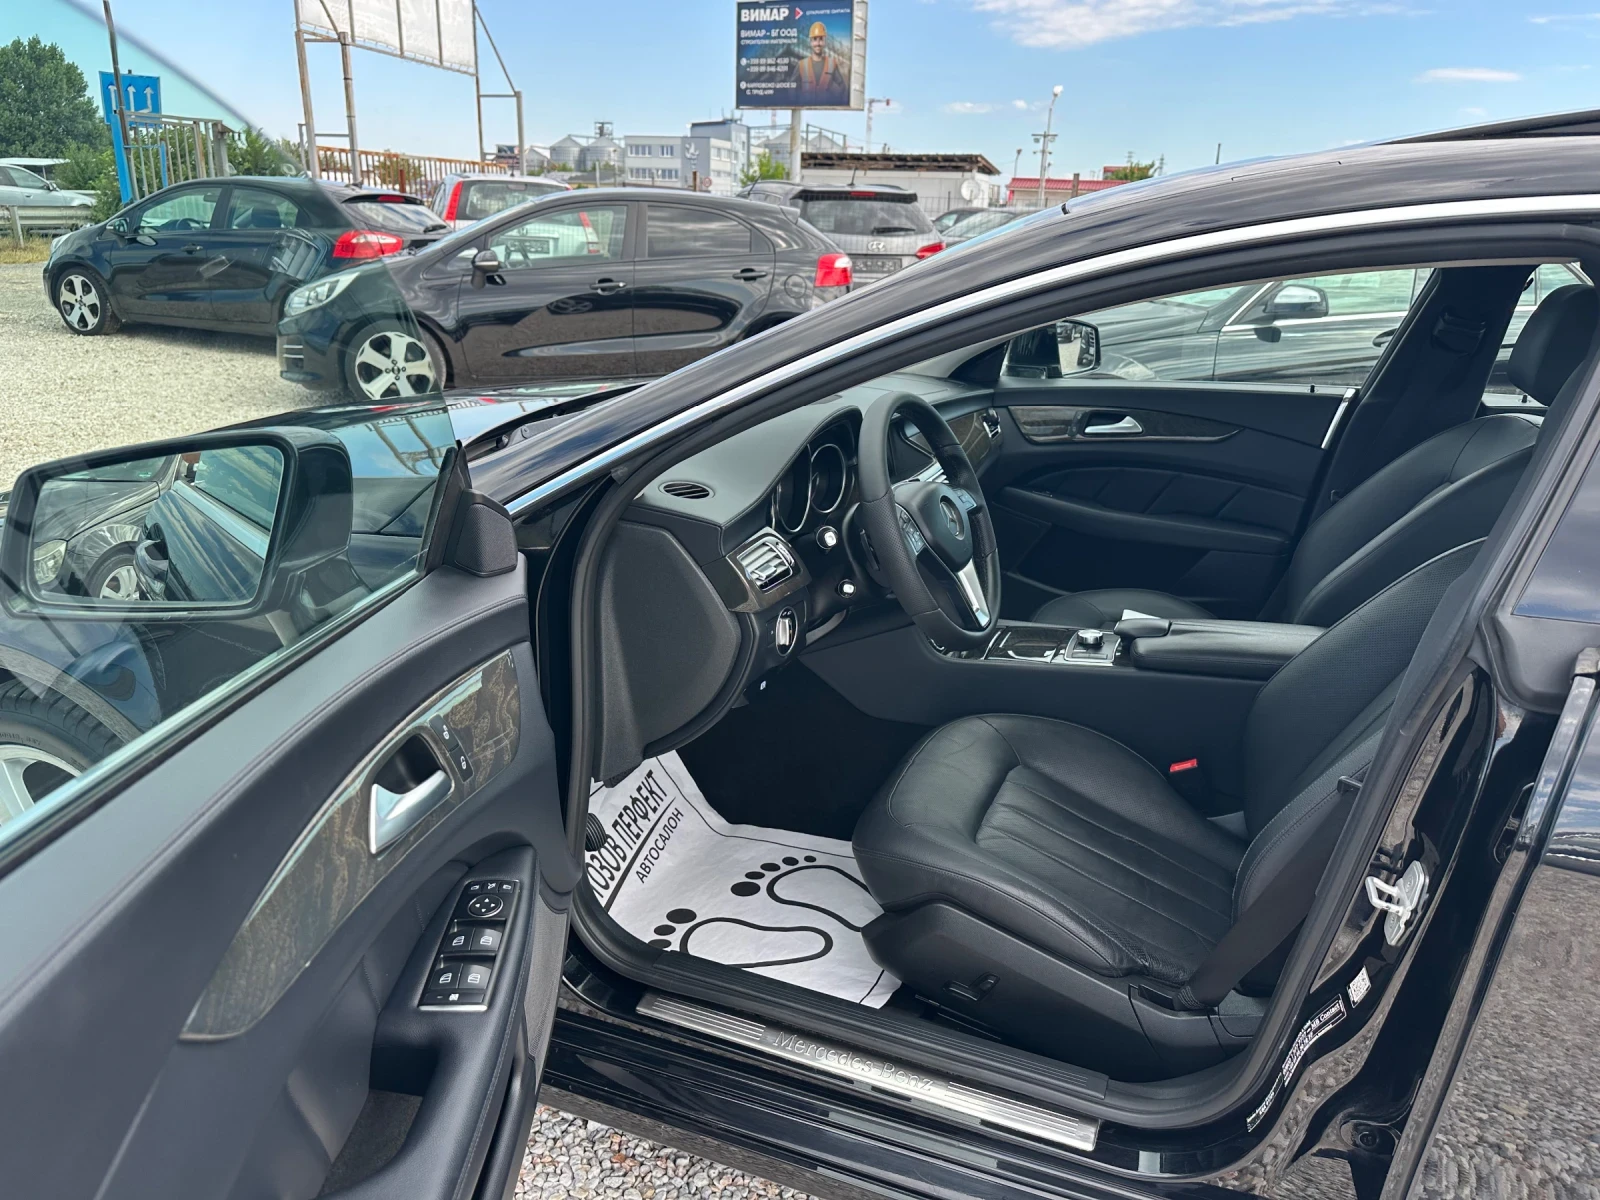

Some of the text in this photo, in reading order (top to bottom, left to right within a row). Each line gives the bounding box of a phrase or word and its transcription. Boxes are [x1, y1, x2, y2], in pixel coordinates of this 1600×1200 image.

[740, 29, 766, 37] ВИМАР
[771, 28, 780, 37] БГ
[780, 28, 798, 37] ООД
[741, 8, 789, 22] ВИМАР
[611, 769, 668, 851] ПЕРФЕКТ
[635, 807, 684, 884] АВТОСАЛОН
[772, 1031, 934, 1092] Mercedes-Benz
